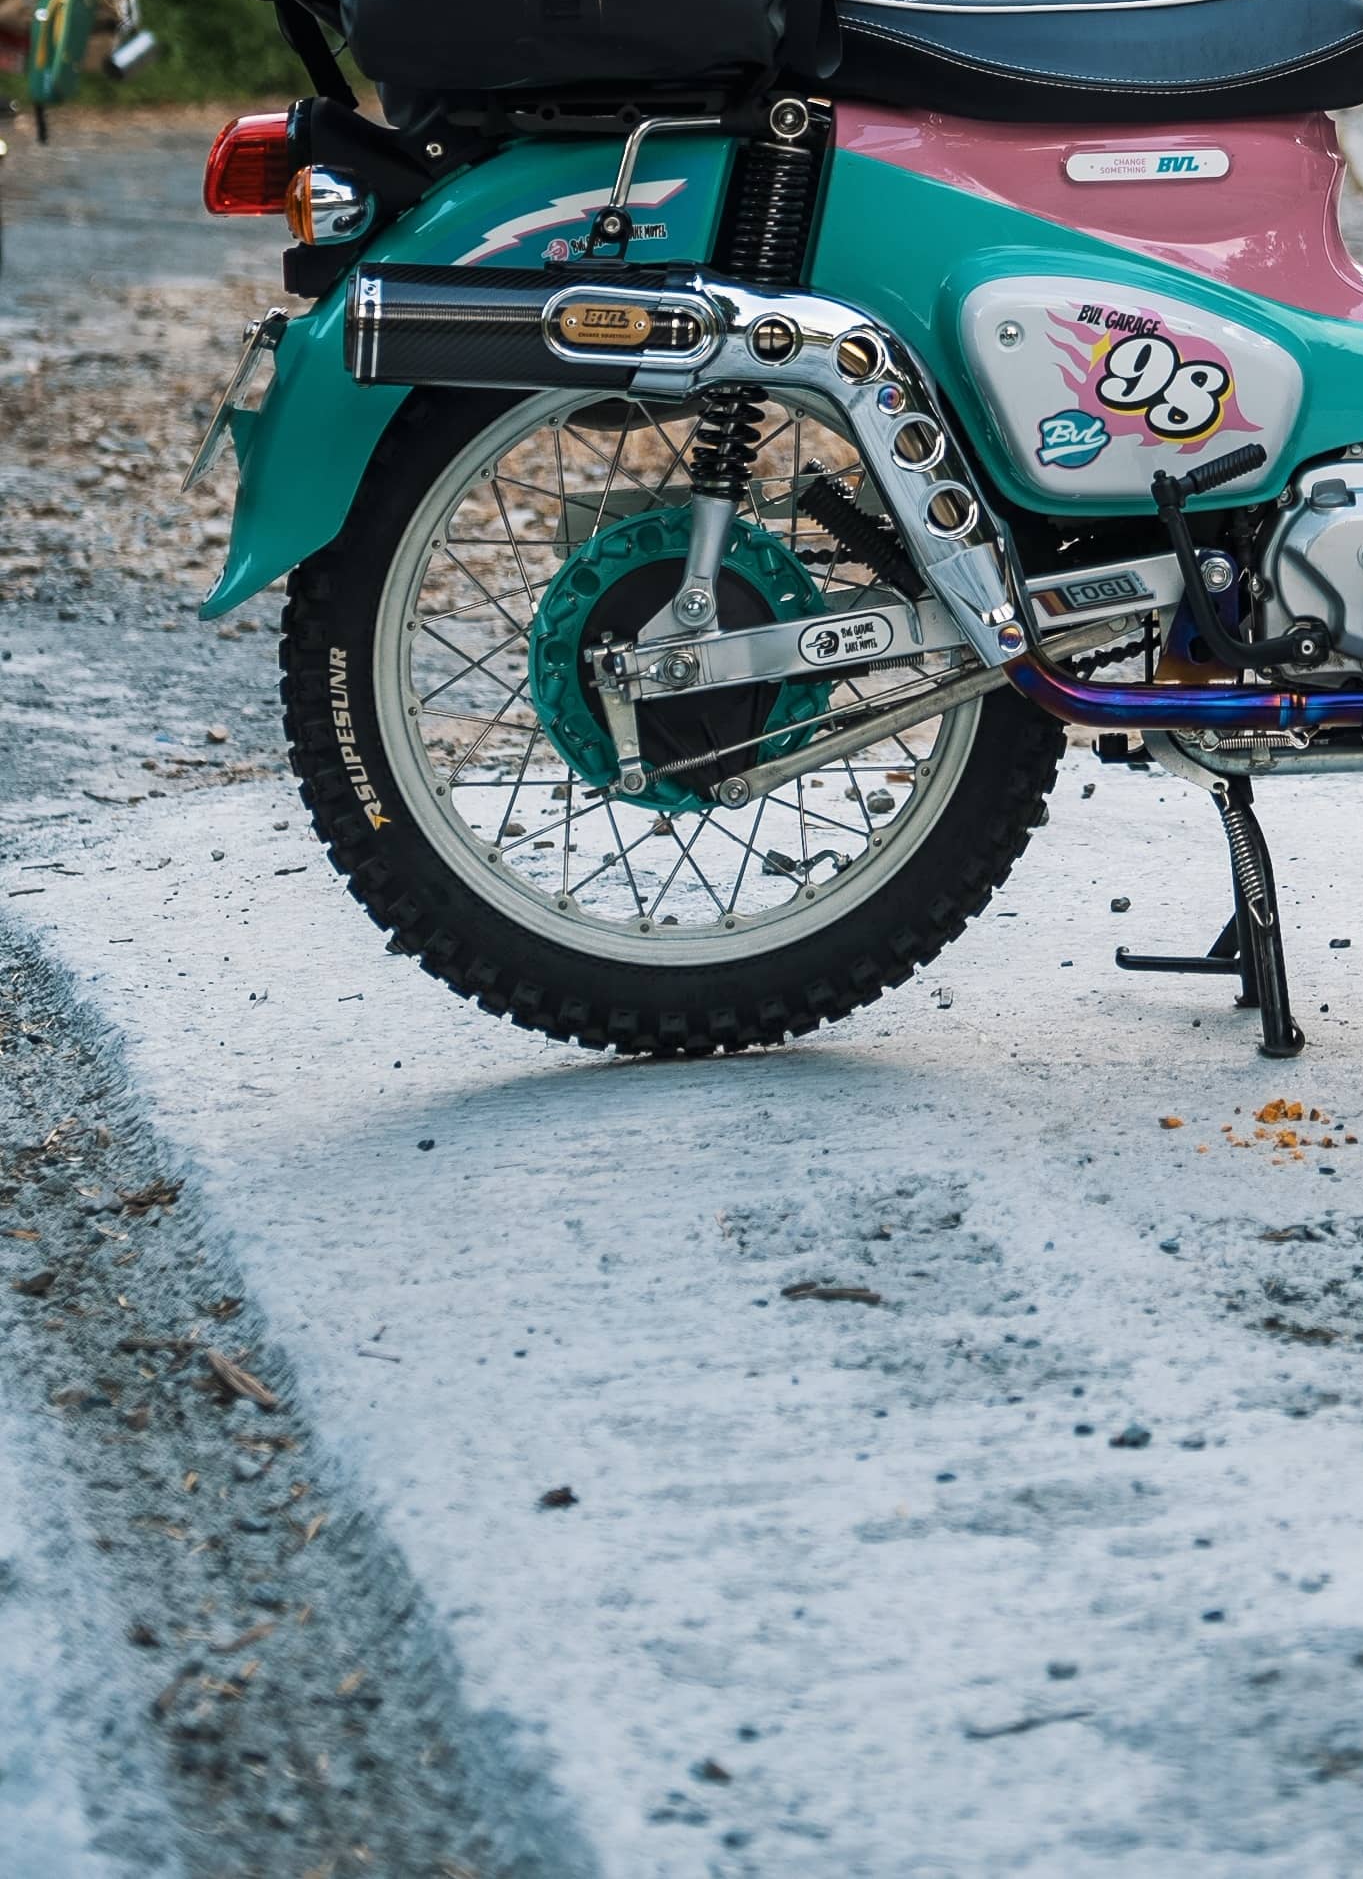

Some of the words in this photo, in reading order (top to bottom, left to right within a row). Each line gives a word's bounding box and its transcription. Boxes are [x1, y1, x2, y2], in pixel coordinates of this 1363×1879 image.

[1099, 165, 1147, 175] SOMETHING
[1113, 157, 1147, 167] CHANGE
[1156, 155, 1200, 174] BVL
[582, 308, 629, 329] BVL
[1077, 304, 1104, 327] BVL
[1105, 310, 1162, 336] GARAGE
[1096, 334, 1232, 441] 98
